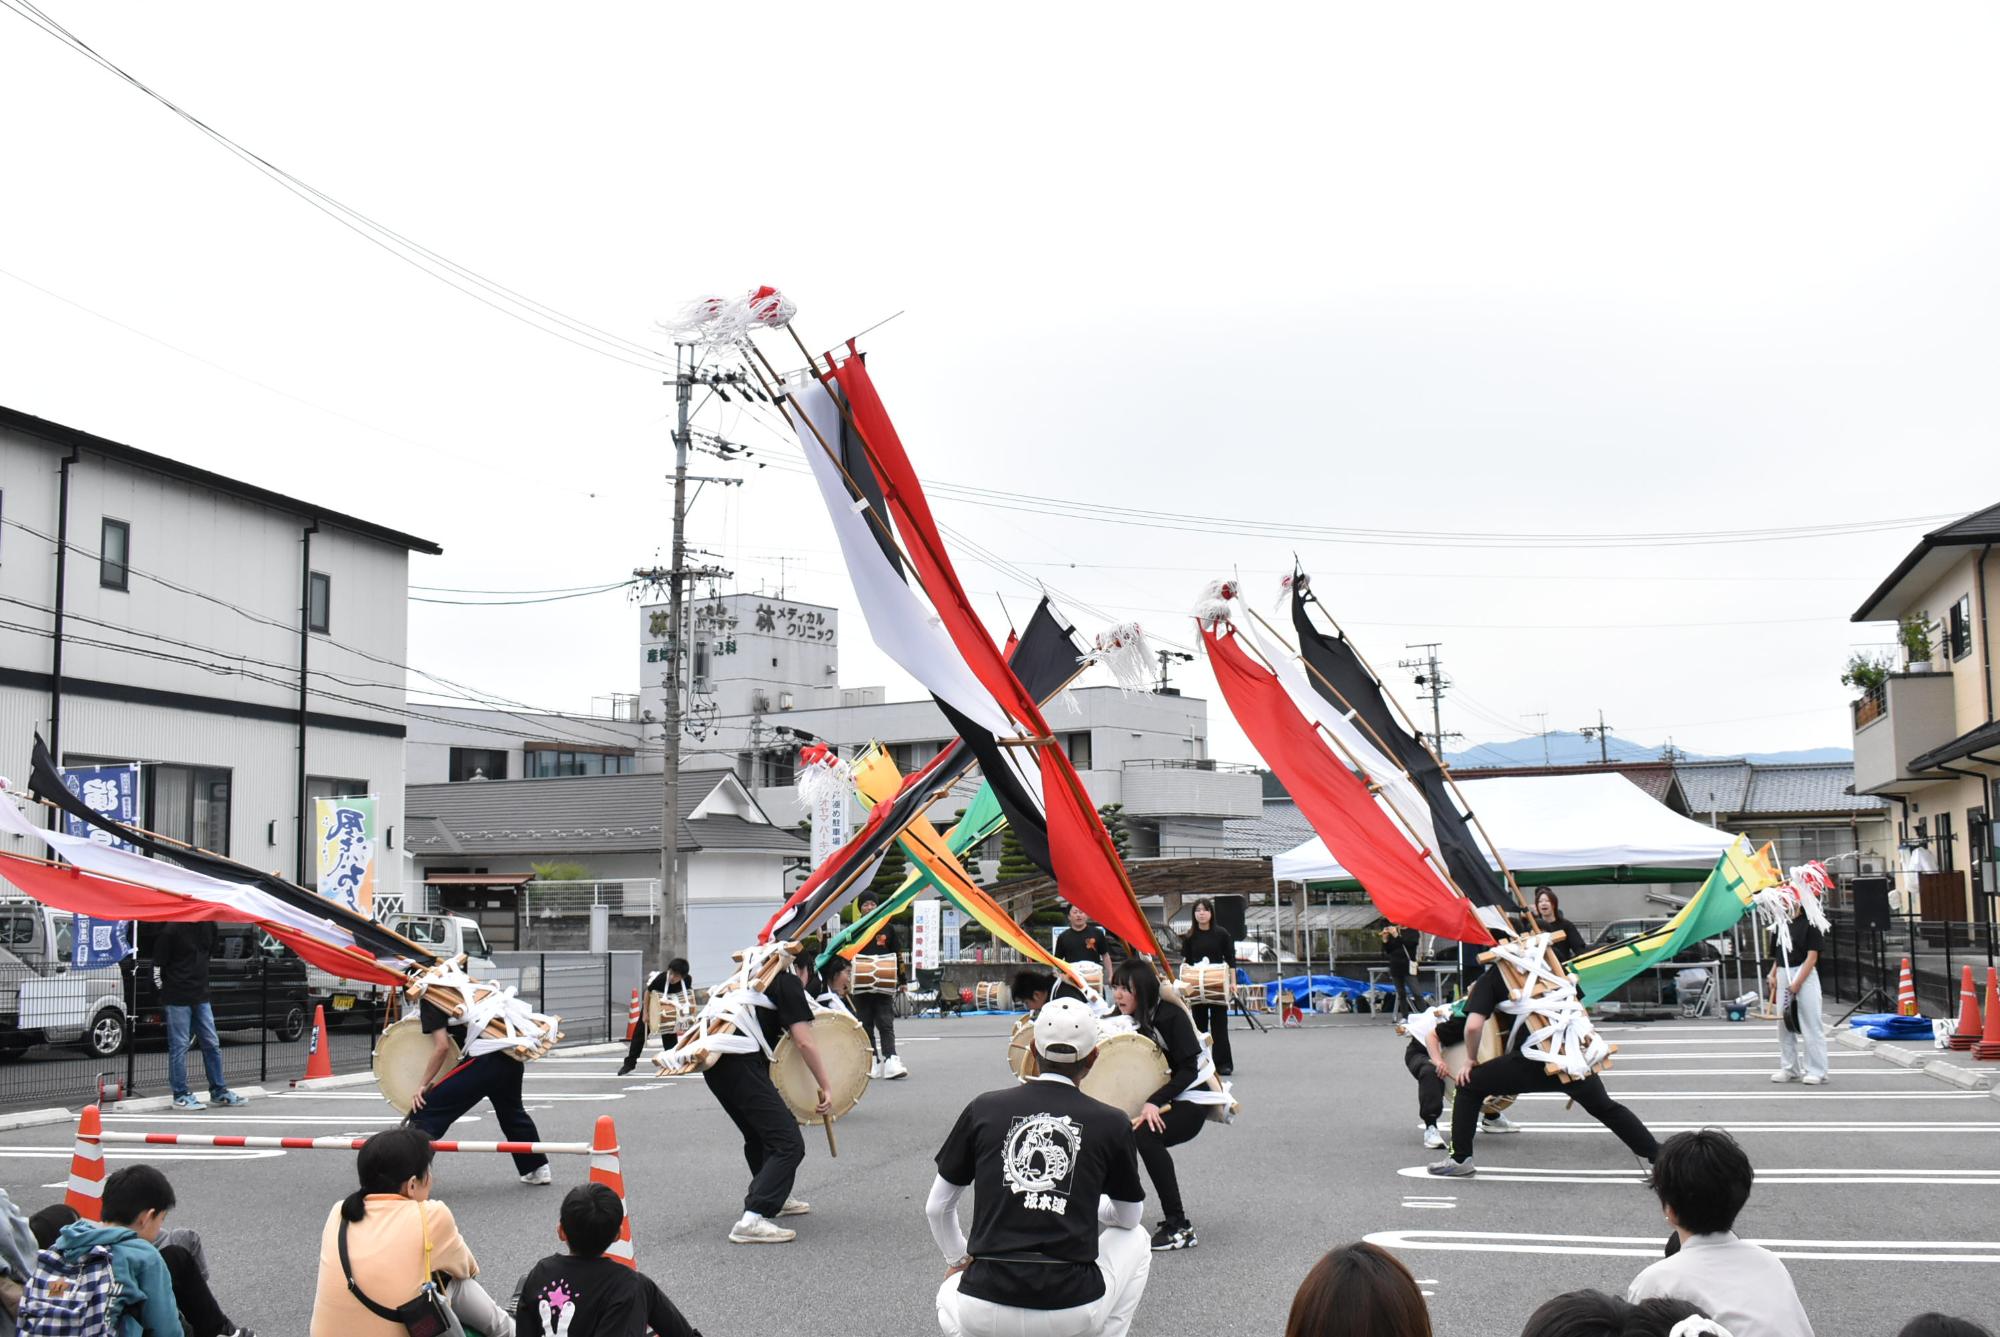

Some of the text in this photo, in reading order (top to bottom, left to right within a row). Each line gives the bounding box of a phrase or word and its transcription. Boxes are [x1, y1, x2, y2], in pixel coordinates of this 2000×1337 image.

[776, 606, 826, 626] メディカル
[786, 622, 835, 642] クリニック
